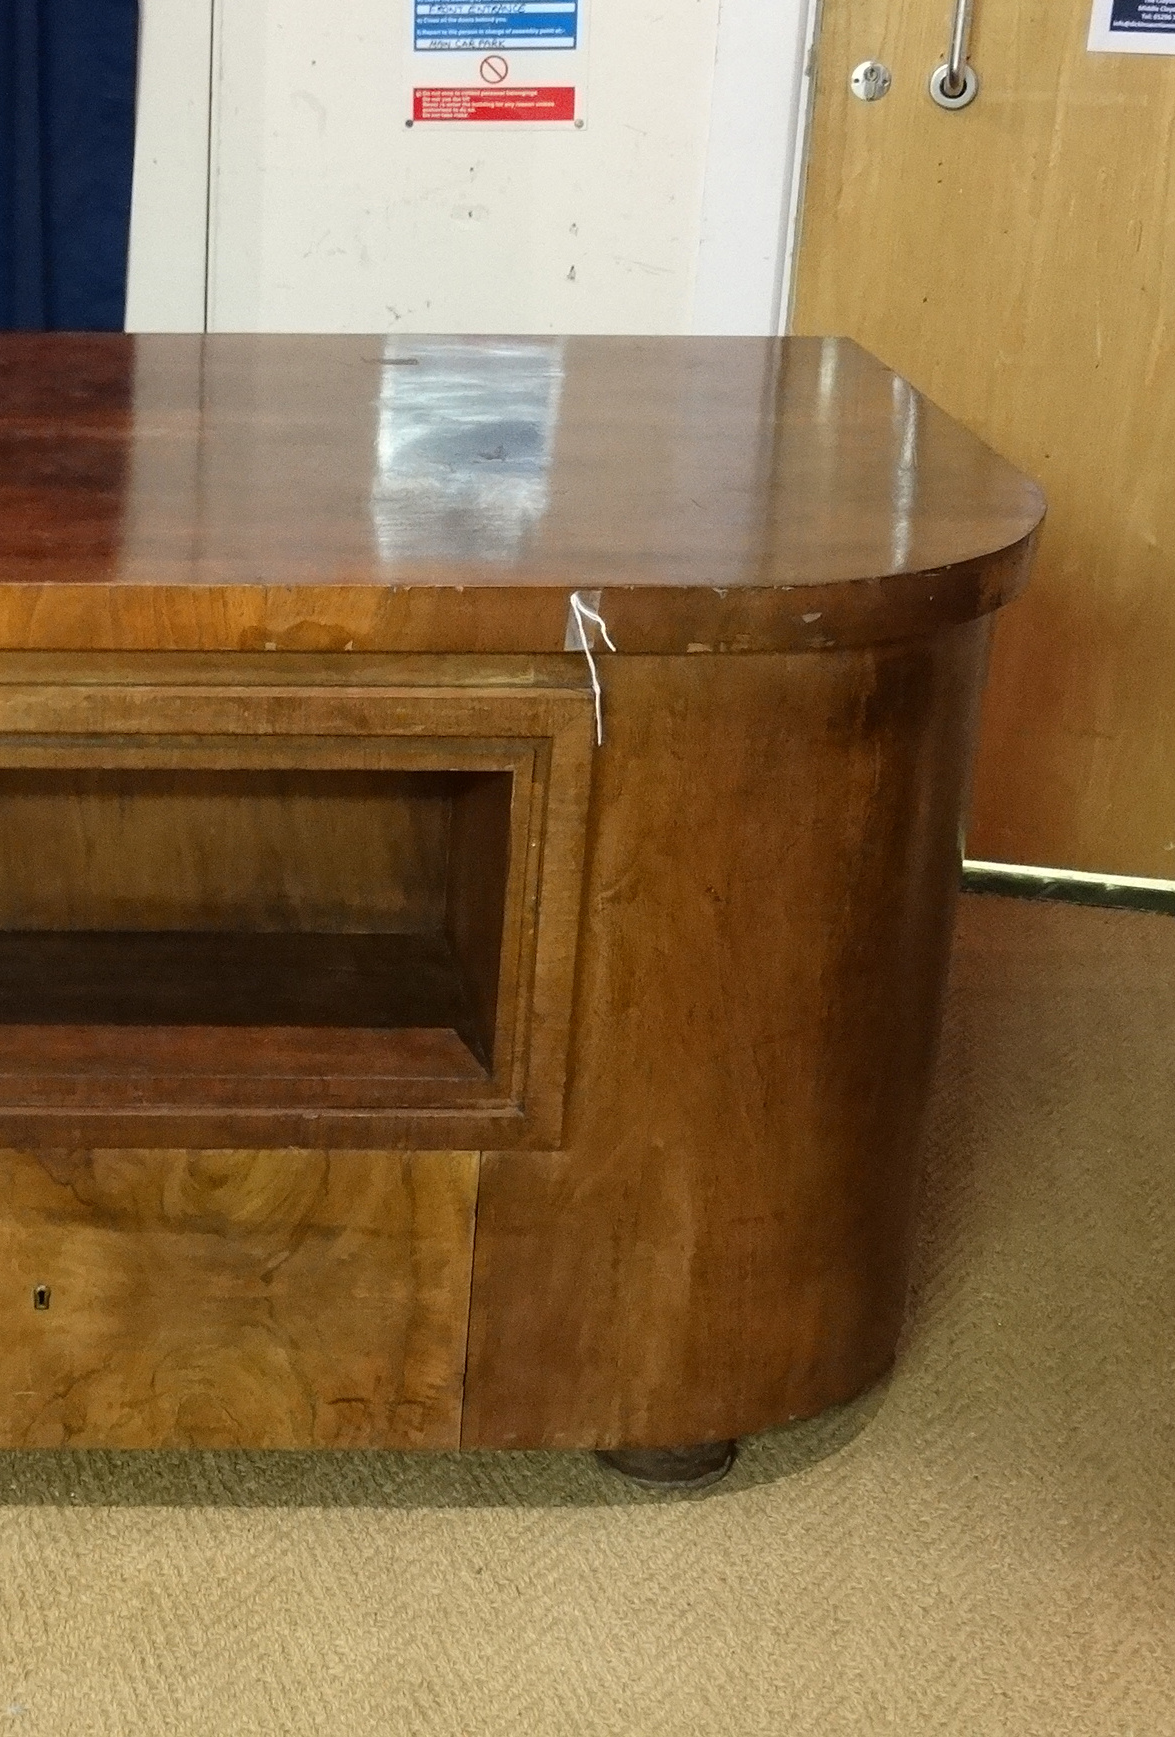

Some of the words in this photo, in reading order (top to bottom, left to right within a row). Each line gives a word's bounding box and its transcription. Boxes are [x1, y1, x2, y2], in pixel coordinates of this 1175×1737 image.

[428, 4, 463, 14] FRONT
[468, 3, 526, 14] ENTRANCE
[455, 40, 477, 49] CAR
[478, 39, 505, 49] PARK
